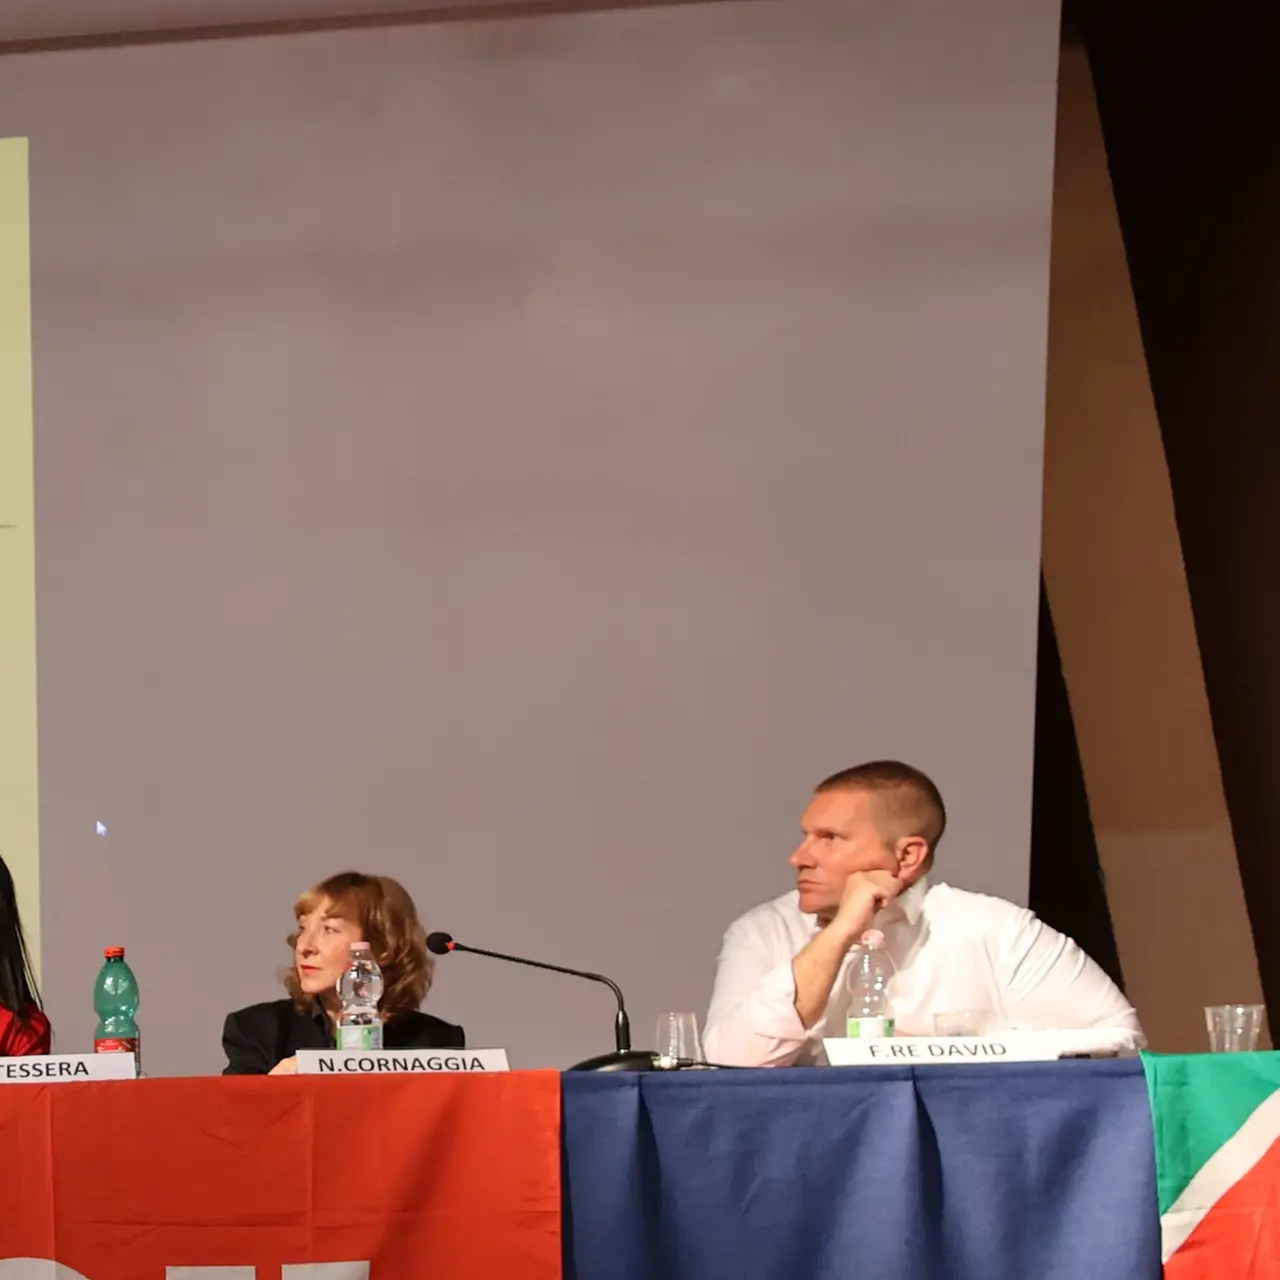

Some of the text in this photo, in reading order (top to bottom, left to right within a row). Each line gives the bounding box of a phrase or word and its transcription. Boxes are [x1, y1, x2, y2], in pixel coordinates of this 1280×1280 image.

[869, 1042, 1008, 1058] F.RE DAVID
[318, 1056, 486, 1073] N.CORNAGGIA
